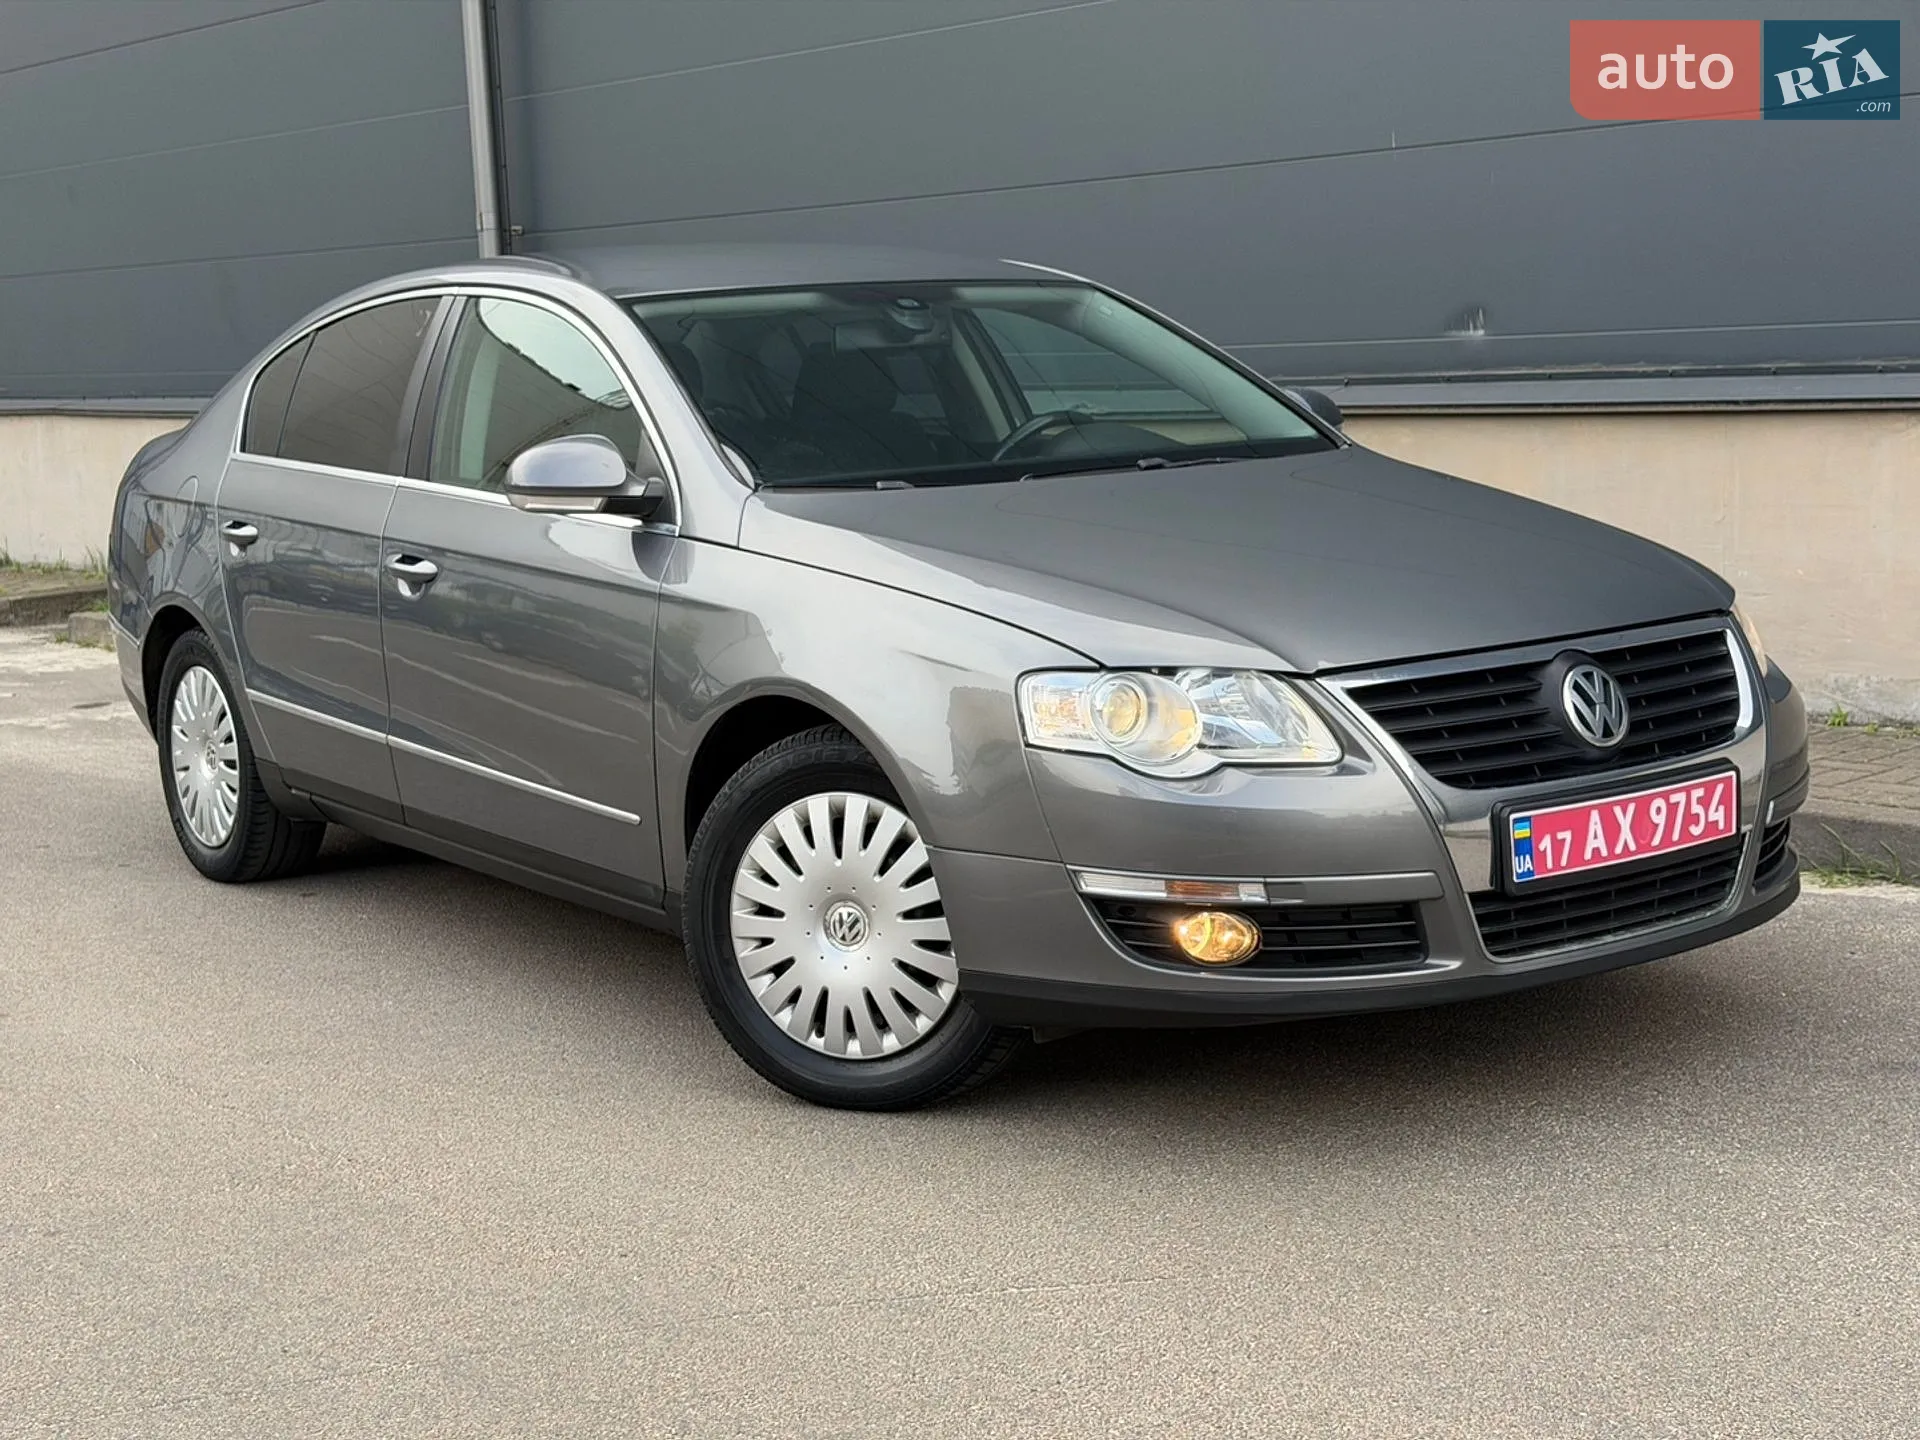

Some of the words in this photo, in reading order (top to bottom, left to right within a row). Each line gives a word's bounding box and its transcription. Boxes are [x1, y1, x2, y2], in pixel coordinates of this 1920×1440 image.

[1567, 667, 1626, 742] VW
[1538, 829, 1572, 870] 17
[1583, 802, 1637, 861] AX
[1649, 783, 1725, 847] 9754
[1514, 855, 1534, 874] UA
